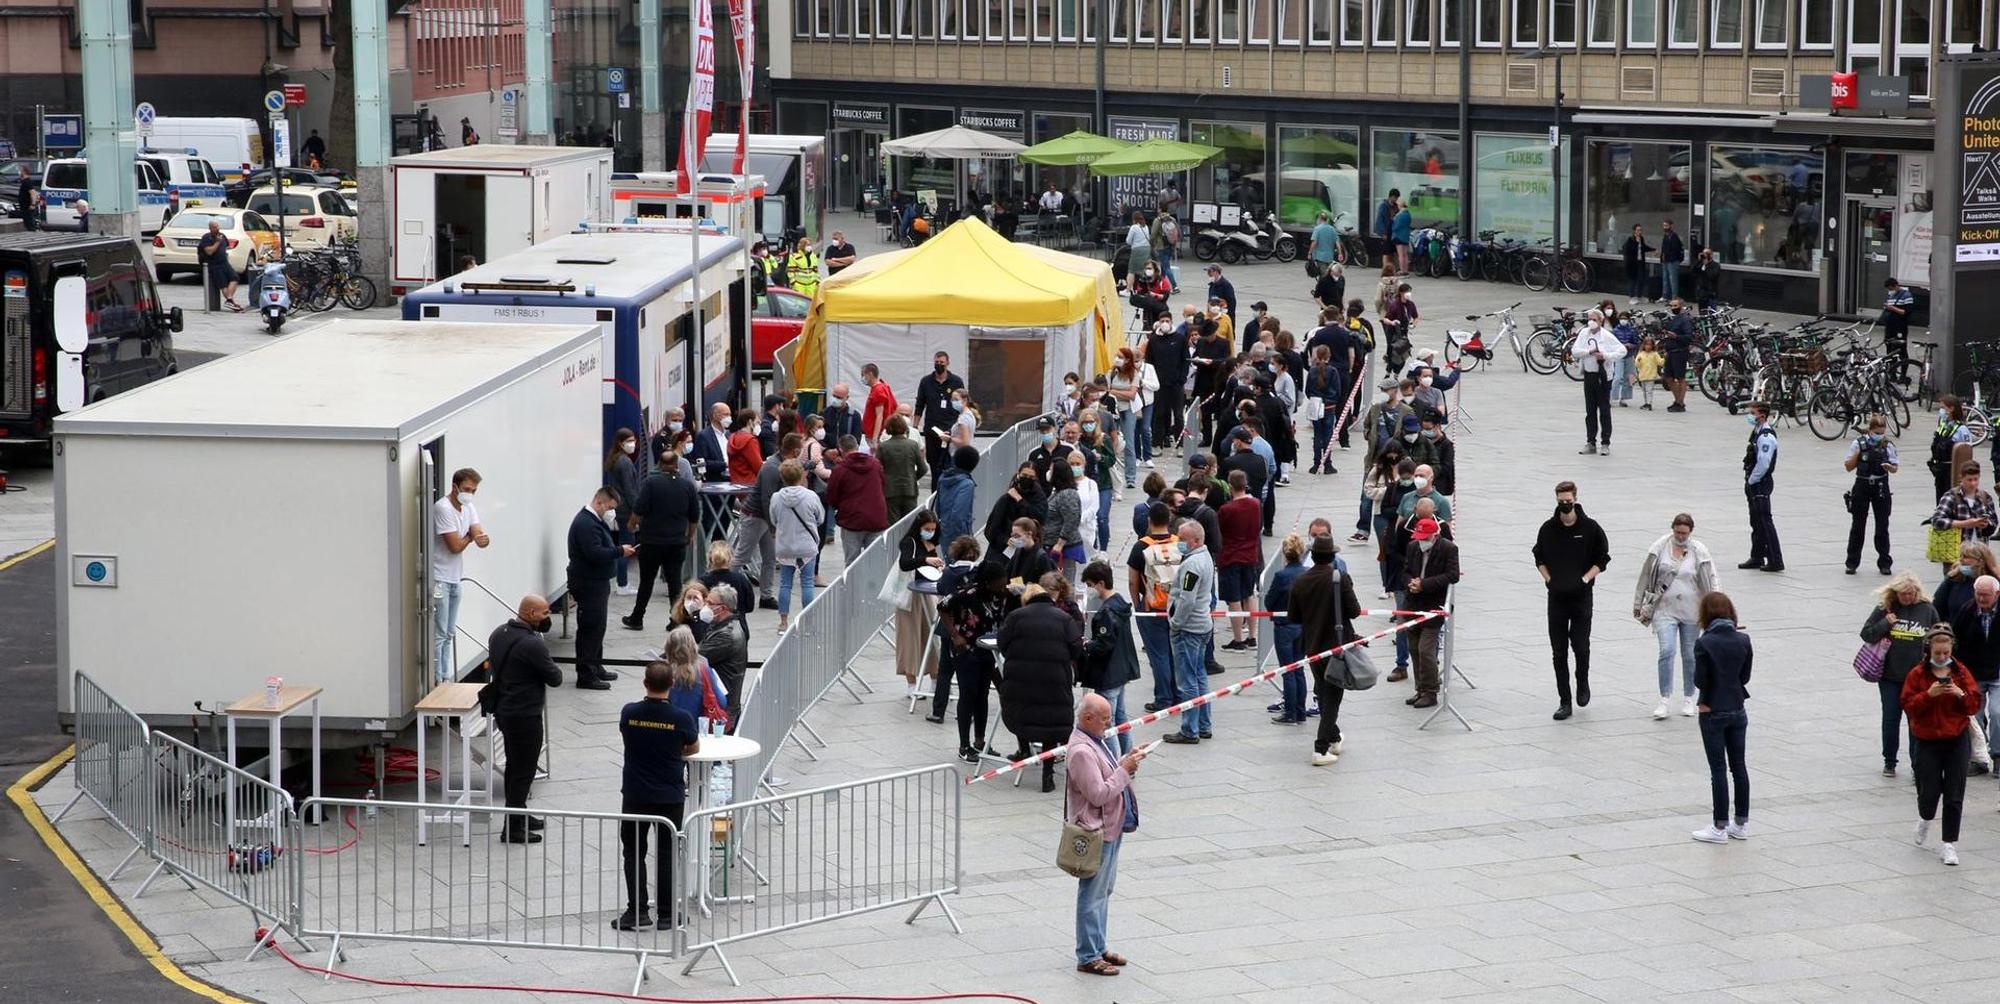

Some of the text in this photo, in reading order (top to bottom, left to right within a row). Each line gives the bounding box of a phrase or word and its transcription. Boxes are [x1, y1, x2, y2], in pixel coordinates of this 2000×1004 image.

[1831, 82, 1848, 97] ibis
[832, 108, 882, 120] STARBUCKS COFFEE
[960, 116, 1017, 128] STARBUCKS COFFEE
[1115, 128, 1173, 141] FRESH MADE
[1116, 176, 1159, 195] JUICES
[46, 190, 76, 199] POLIZEI
[1961, 229, 2000, 241] Kick-Off
